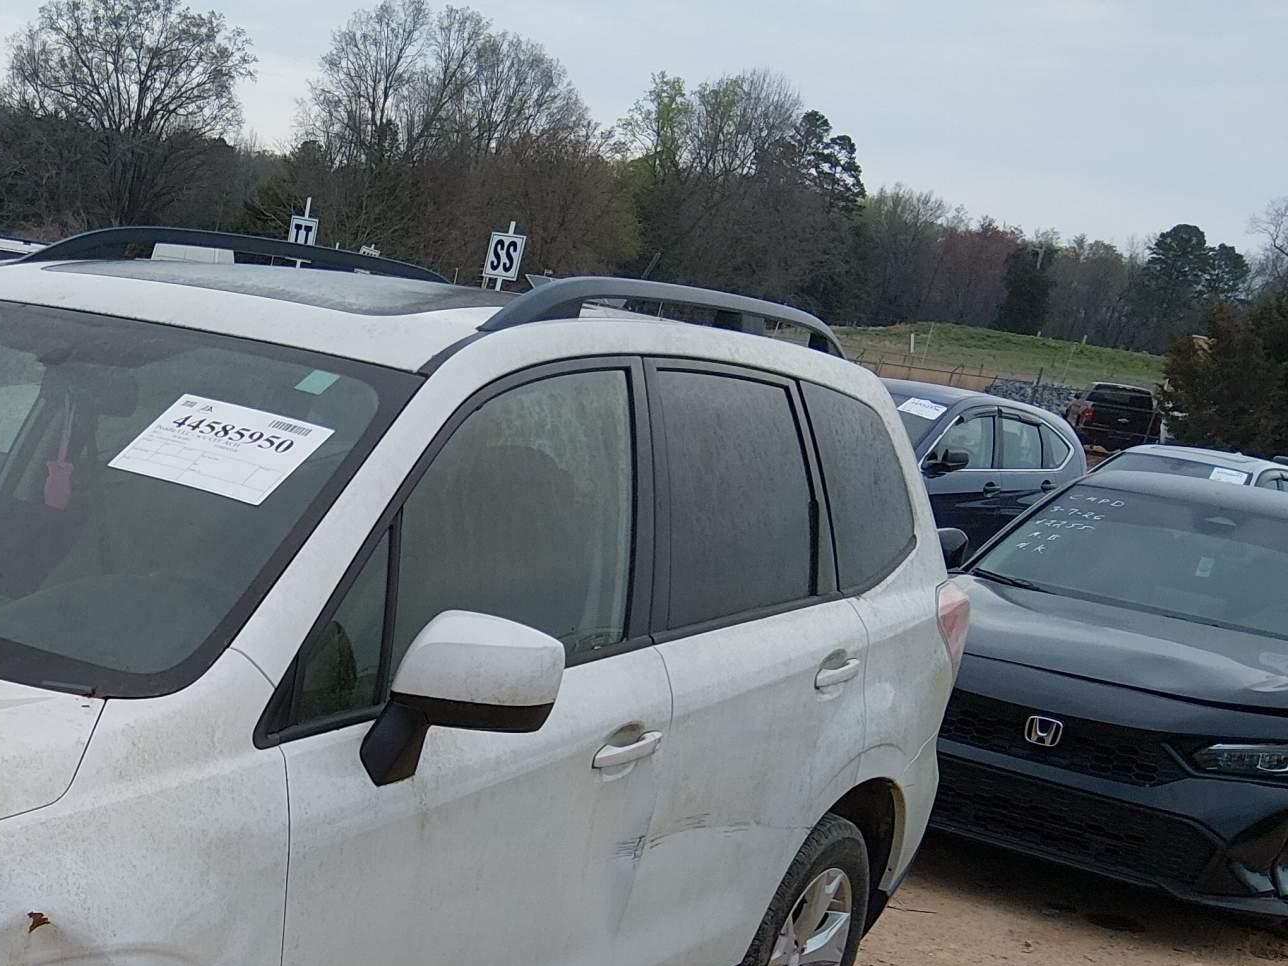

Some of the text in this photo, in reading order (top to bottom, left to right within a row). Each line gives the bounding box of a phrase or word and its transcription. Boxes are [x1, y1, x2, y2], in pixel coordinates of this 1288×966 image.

[294, 223, 313, 245] TT
[490, 238, 518, 273] SS
[173, 415, 294, 453] 44585950
